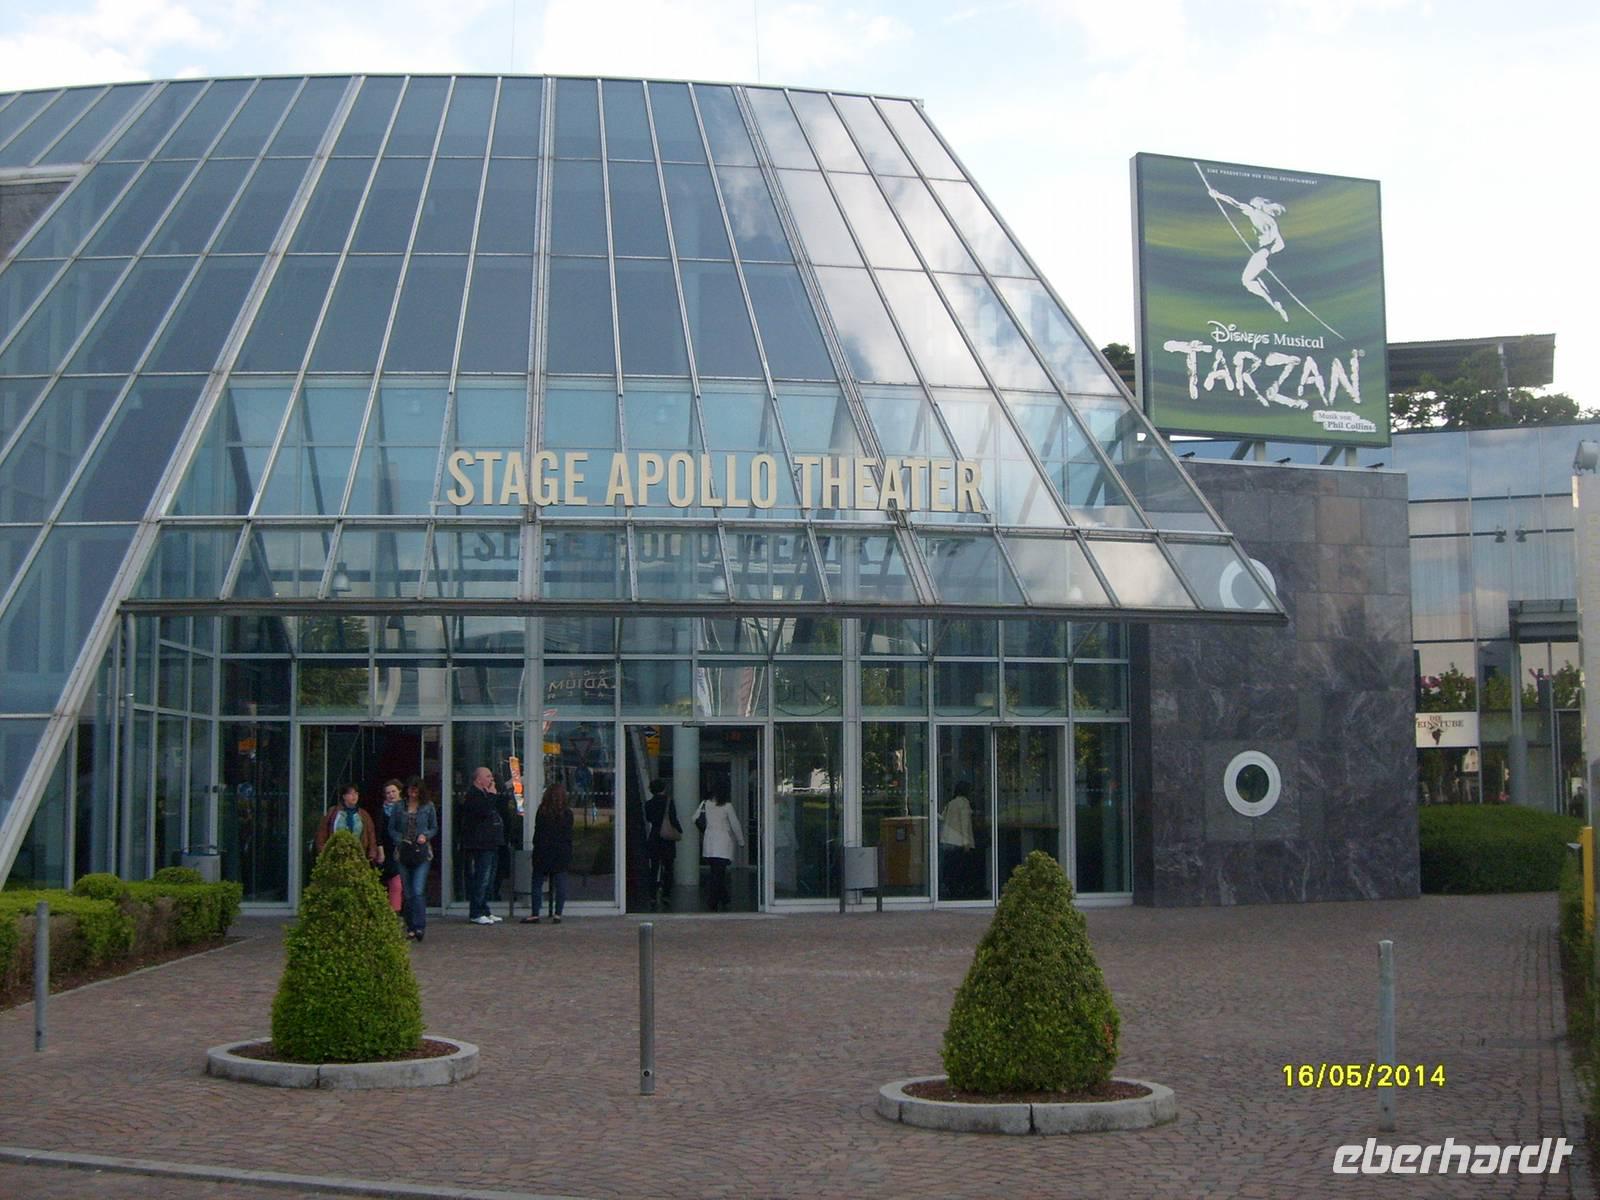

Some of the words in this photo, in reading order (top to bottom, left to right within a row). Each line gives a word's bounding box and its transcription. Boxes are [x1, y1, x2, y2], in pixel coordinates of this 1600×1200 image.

[1273, 333, 1325, 349] Musical
[1163, 340, 1361, 410] TARZAN
[1327, 421, 1344, 429] Phil
[1345, 422, 1373, 431] Collins
[447, 450, 589, 507] STAGE
[605, 452, 777, 509] APOLLO
[793, 455, 983, 513] THEATER
